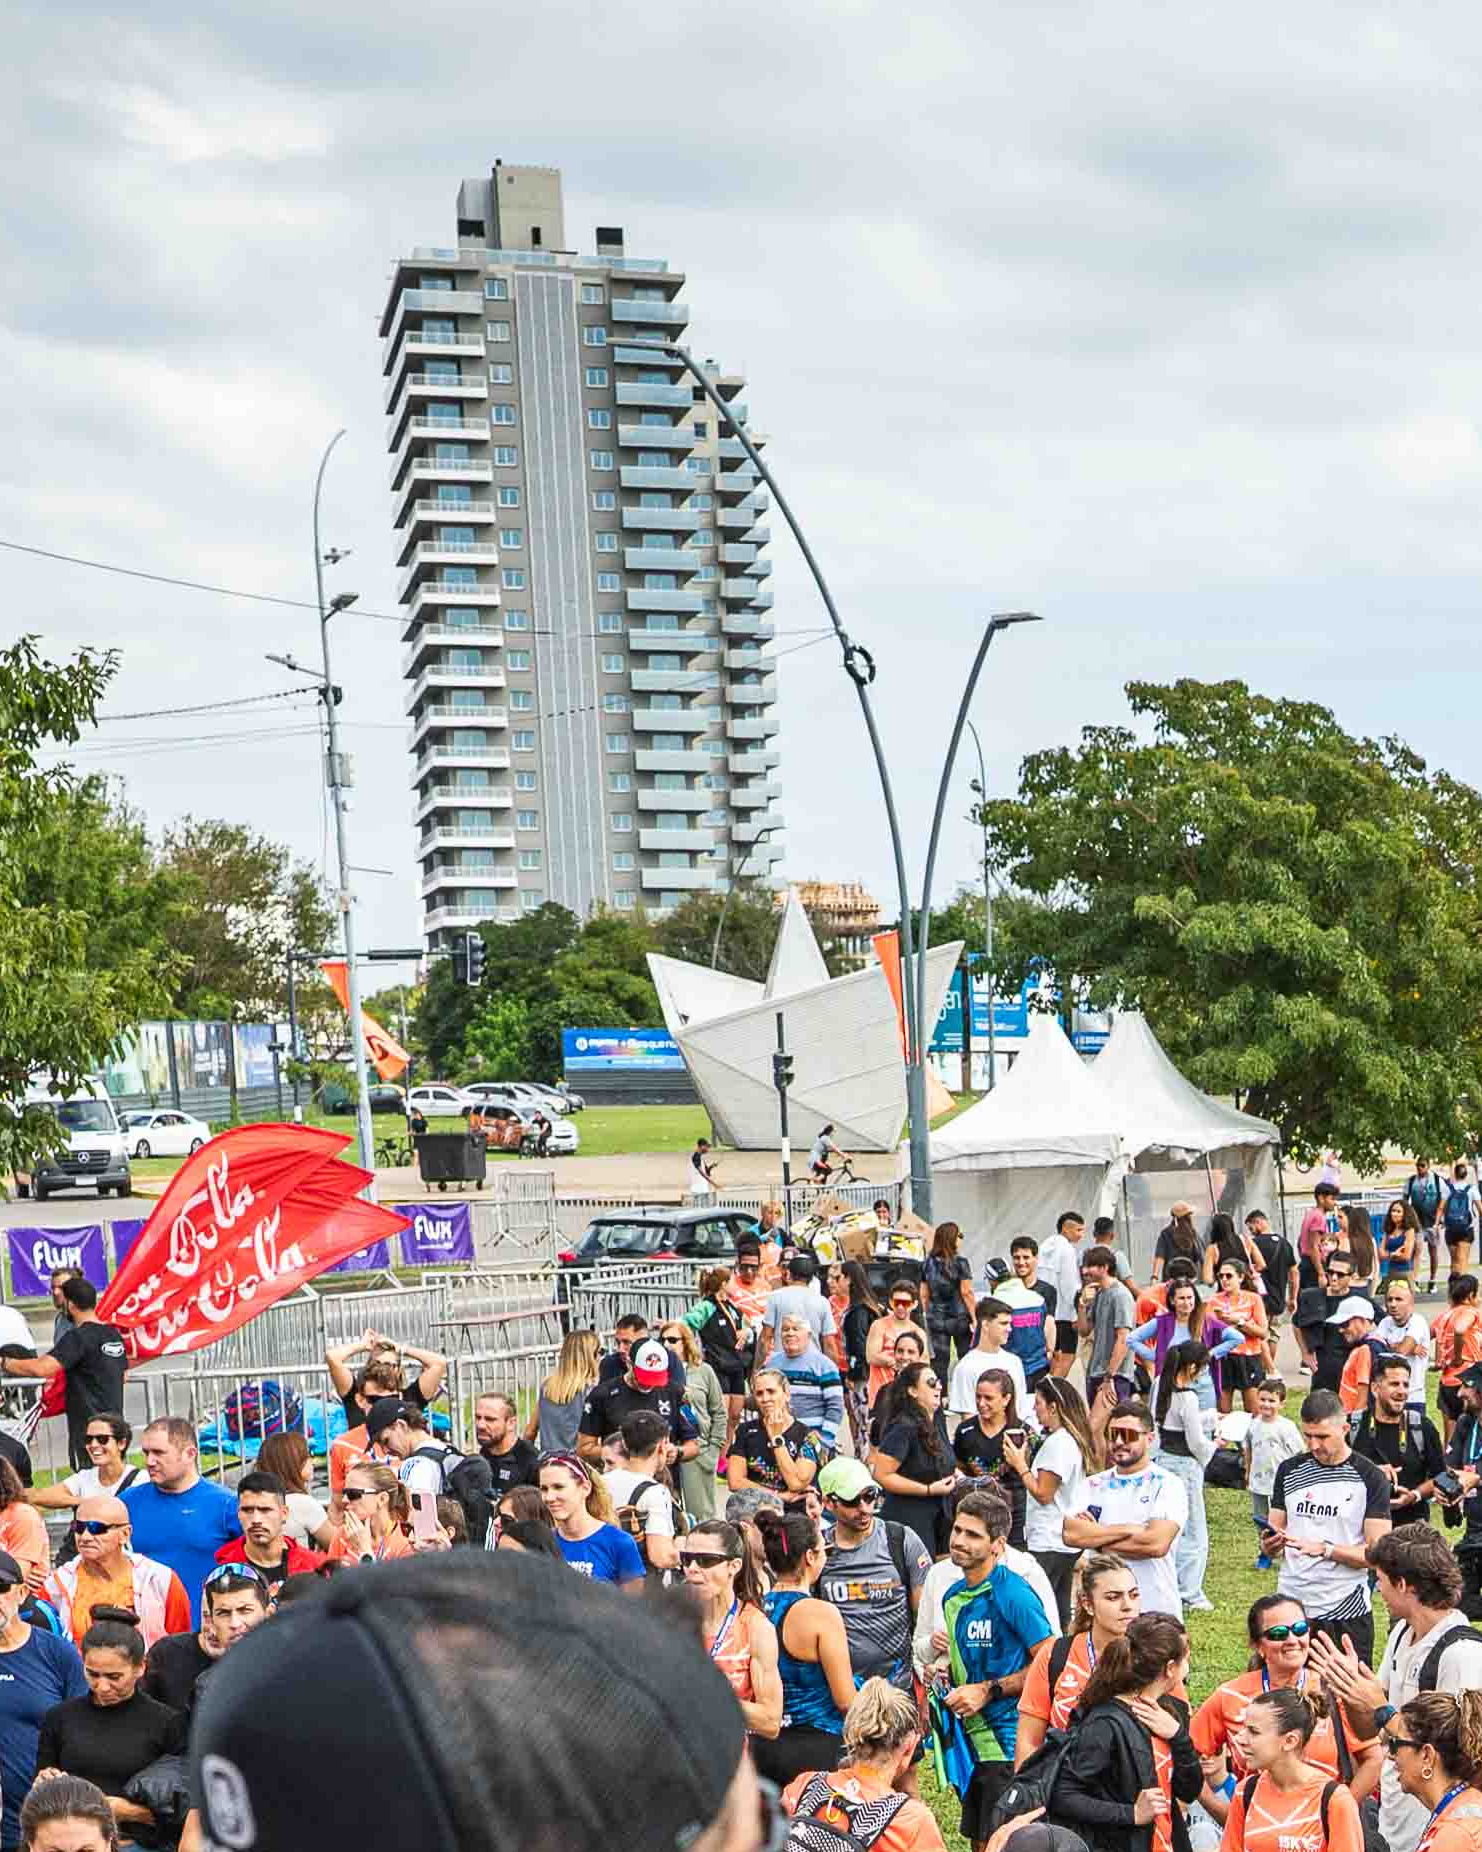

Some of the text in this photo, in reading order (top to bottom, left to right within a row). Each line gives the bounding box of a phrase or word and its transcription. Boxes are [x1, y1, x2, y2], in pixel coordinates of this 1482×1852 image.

[824, 1581, 868, 1602] 10K
[869, 1589, 893, 1600] 2024
[967, 1619, 992, 1639] CM
